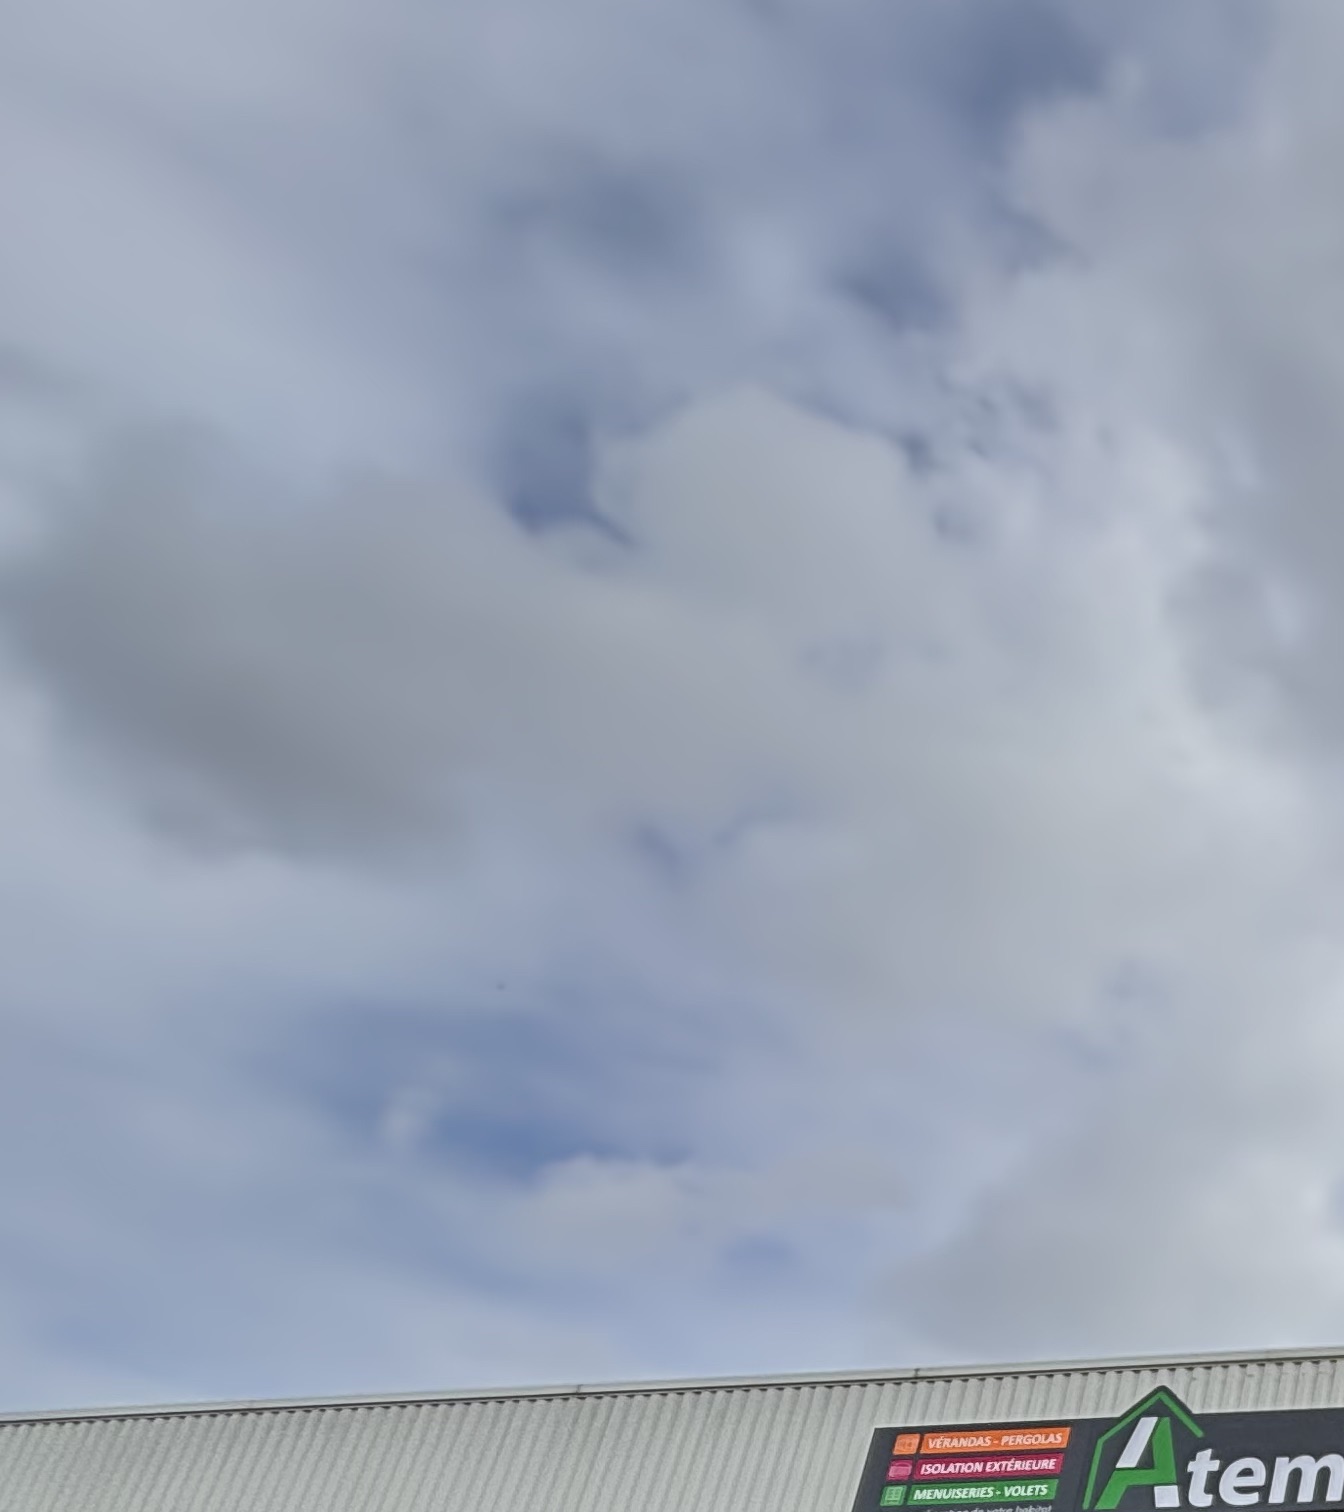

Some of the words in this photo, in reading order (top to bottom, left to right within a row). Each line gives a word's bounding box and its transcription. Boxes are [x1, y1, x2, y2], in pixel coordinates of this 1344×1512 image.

[927, 1436, 992, 1449] VÉRANDAS
[1001, 1432, 1063, 1446] PERGOLAS
[920, 1462, 983, 1475] ISOLATION
[986, 1458, 1057, 1472] EXTÉRIEURE
[913, 1486, 993, 1501] MENUISERIES
[1003, 1484, 1049, 1498] VOLETS
